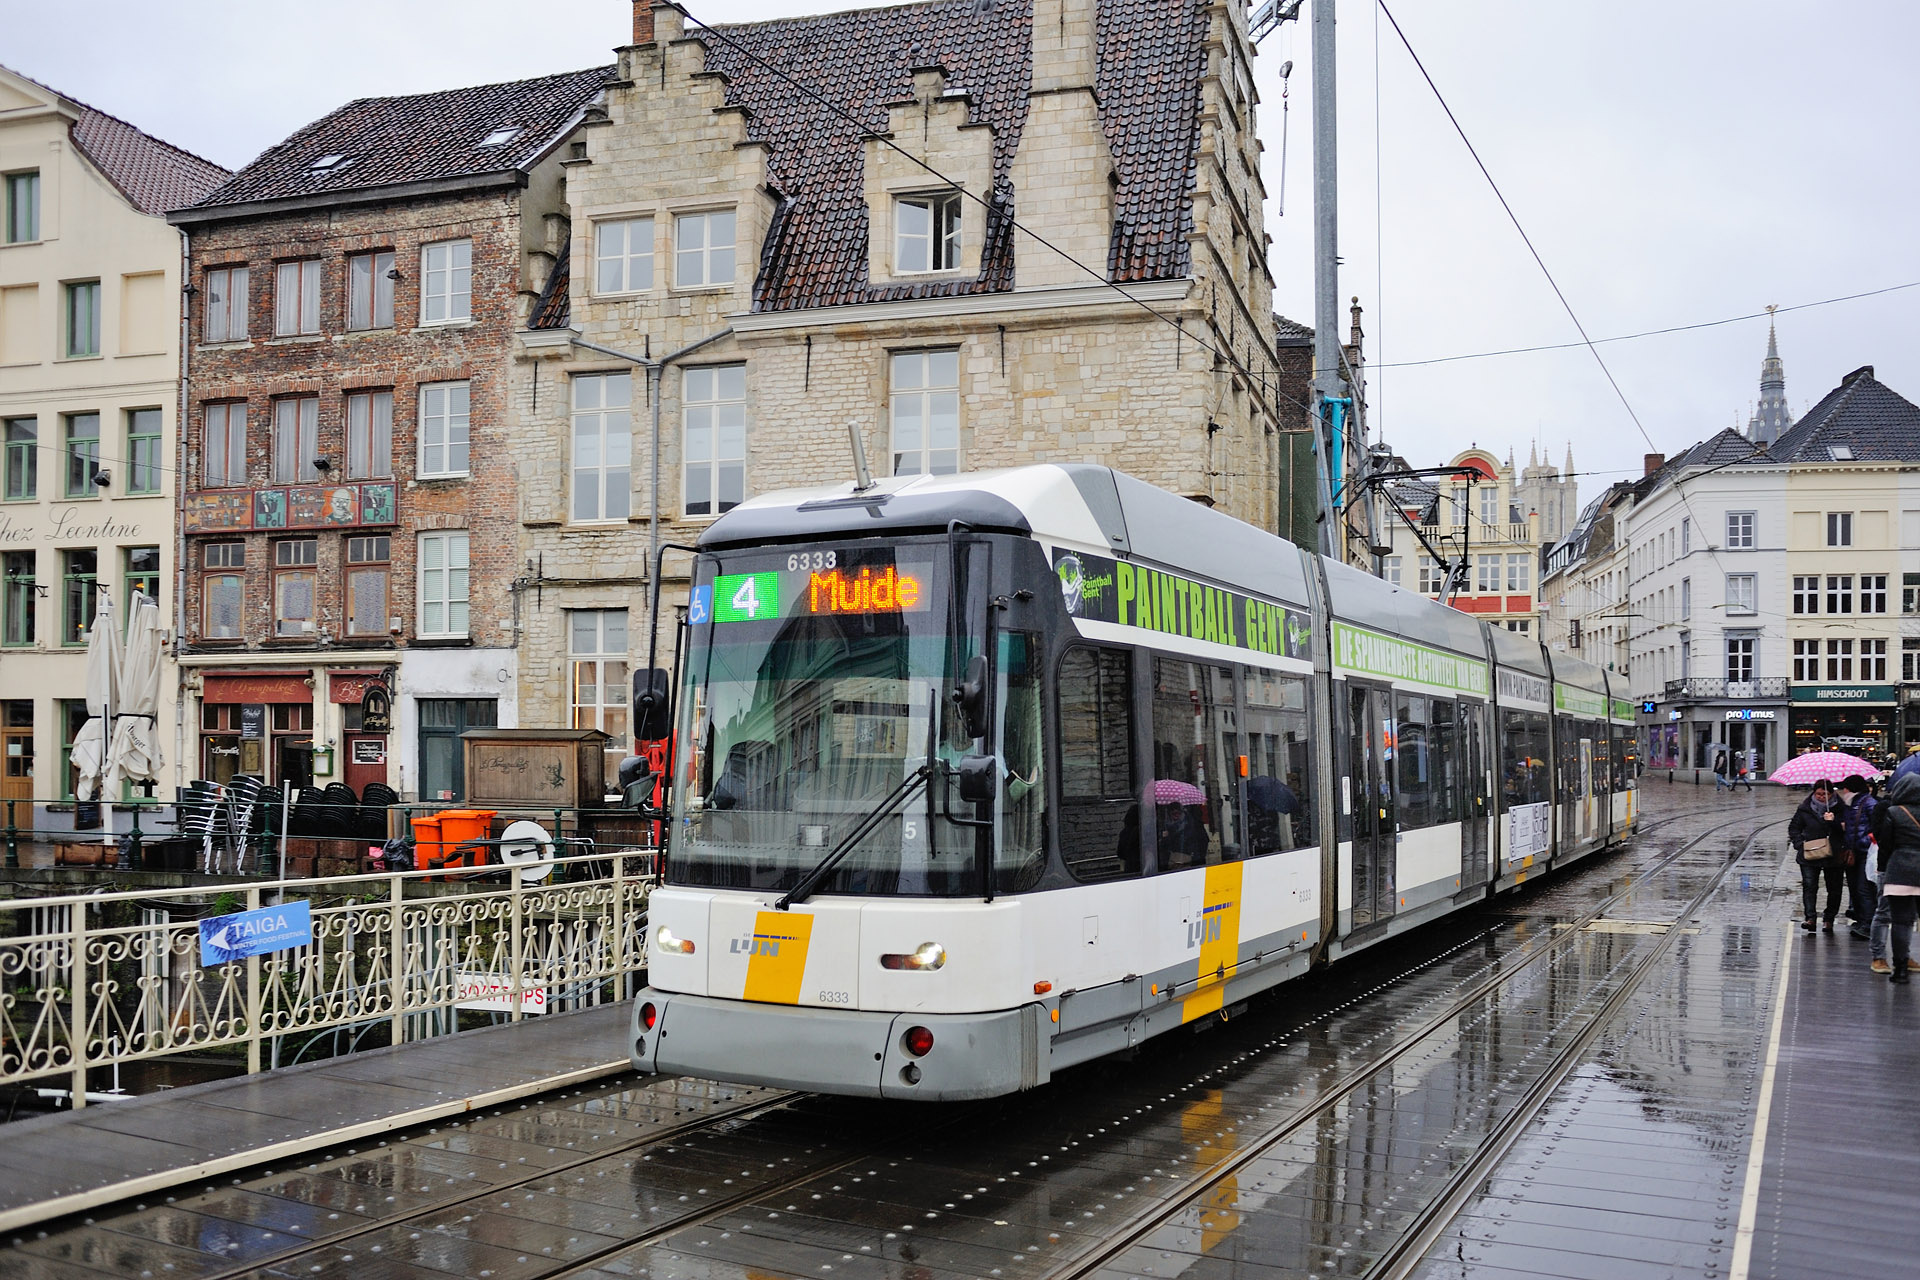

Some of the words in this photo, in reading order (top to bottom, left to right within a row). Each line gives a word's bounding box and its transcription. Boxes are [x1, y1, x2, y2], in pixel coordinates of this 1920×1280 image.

[0, 511, 34, 541] hez
[45, 506, 141, 540] Leontine
[787, 551, 836, 572] 6333
[810, 566, 919, 613] Muide
[1082, 574, 1112, 589] Paintball
[732, 576, 760, 618] 4
[1082, 587, 1099, 599] Gent
[1117, 562, 1237, 647] PAINTBALL
[1245, 598, 1286, 656] GENT
[1339, 628, 1354, 667] DE
[1354, 632, 1417, 680] SPANNENDSTE
[1417, 650, 1456, 687] ACTIVITEIT
[1455, 659, 1470, 689] VAN
[1816, 689, 1870, 699] HIMSCHOOT
[904, 821, 917, 840] 5
[1299, 889, 1312, 903] 6333
[231, 914, 289, 939] TAIGA
[1187, 915, 1222, 949] LIJN
[231, 939, 258, 951] WINTER
[258, 935, 277, 945] FOOD
[277, 930, 308, 942] FESTIVAL
[730, 938, 780, 957] LIJN
[502, 985, 544, 1005] TIPS
[819, 990, 849, 1003] 6333
